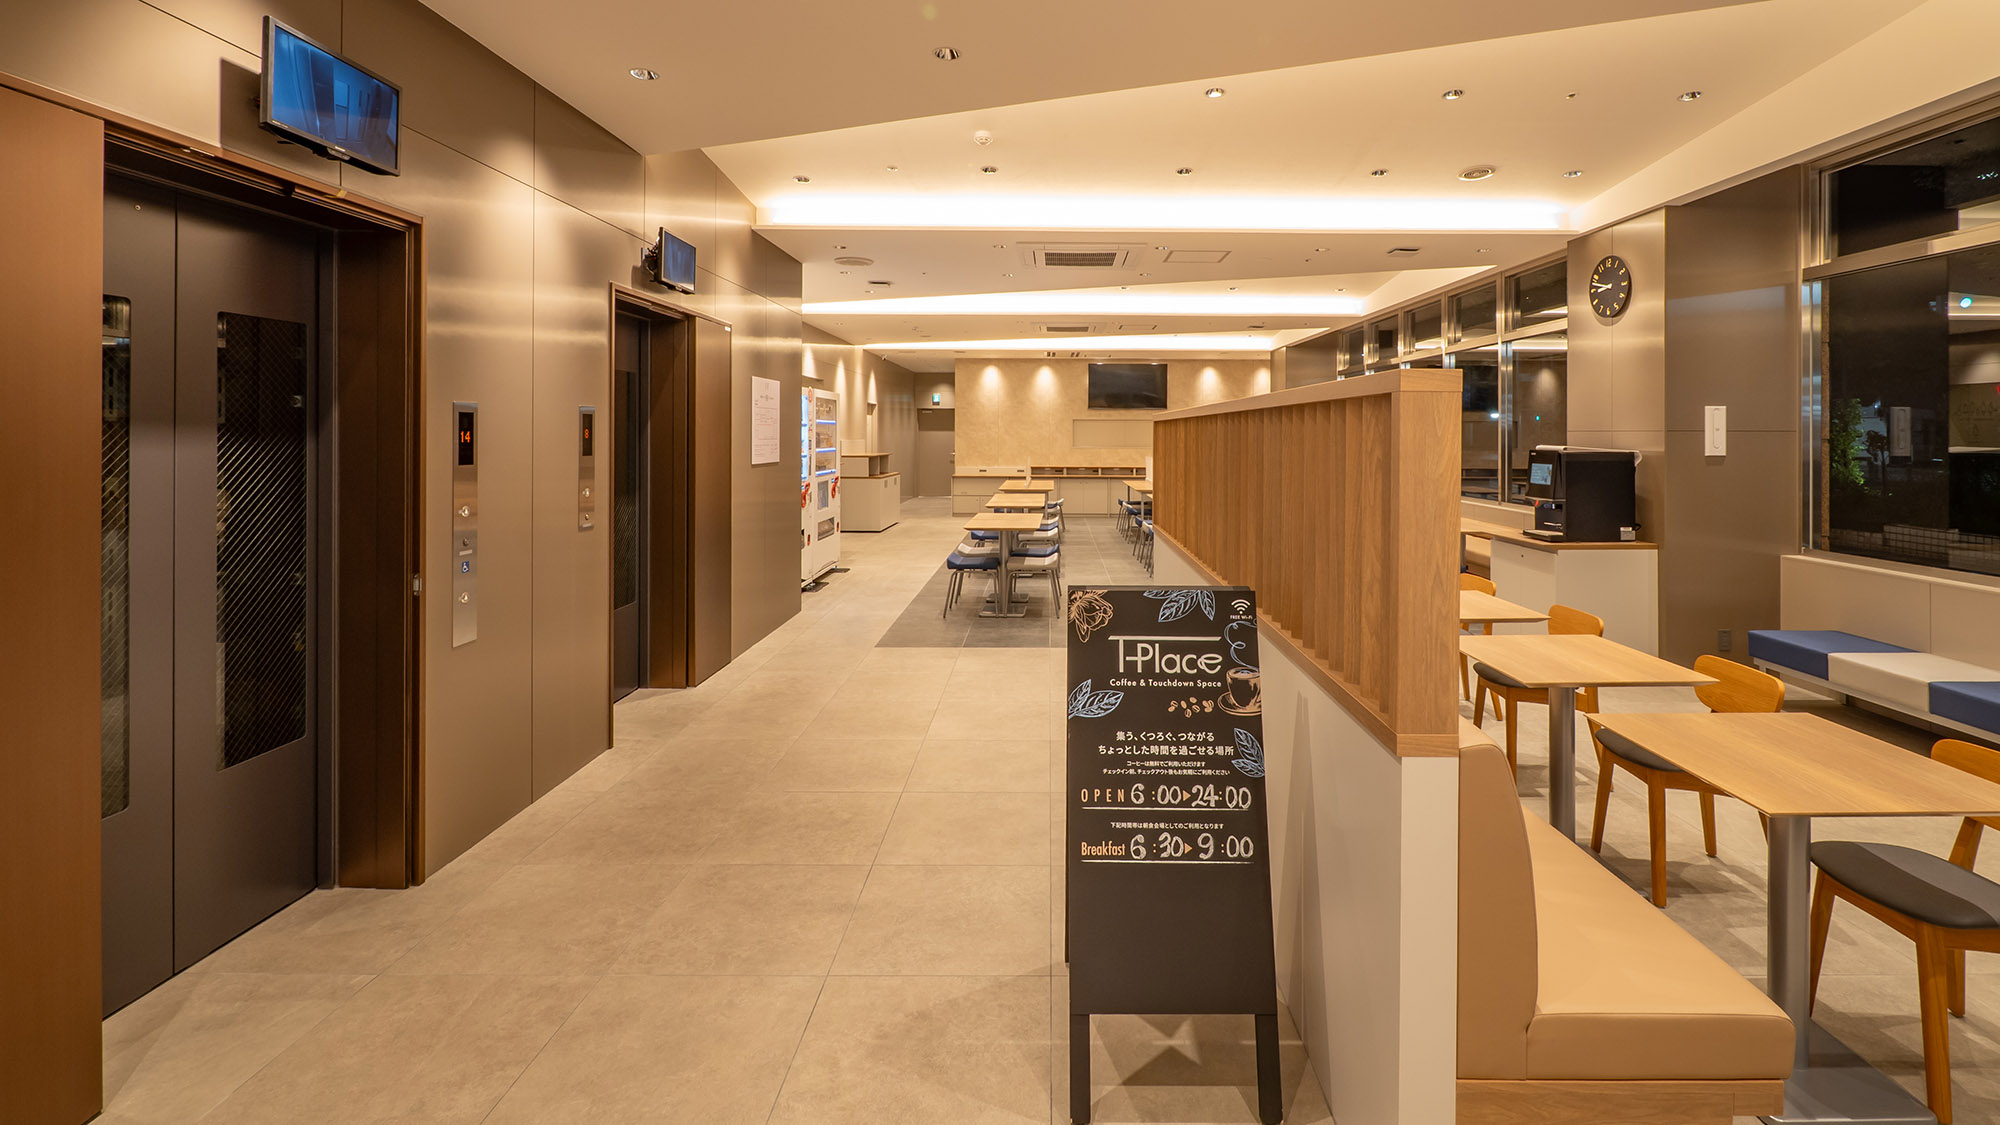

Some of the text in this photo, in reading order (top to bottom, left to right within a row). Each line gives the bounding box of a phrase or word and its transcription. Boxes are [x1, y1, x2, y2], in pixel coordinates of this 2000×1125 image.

[1606, 258, 1611, 267] 12
[460, 431, 471, 443] 14
[584, 428, 590, 439] 8
[1109, 678, 1222, 688] Coffee & Touchdown Space
[1116, 731, 1215, 742] 集う、くつろぐ、つながる
[1098, 745, 1234, 756] ちょっとした時間を過ごせる場所
[1081, 788, 1125, 803] OPEN
[1081, 841, 1126, 856] Breakfast
